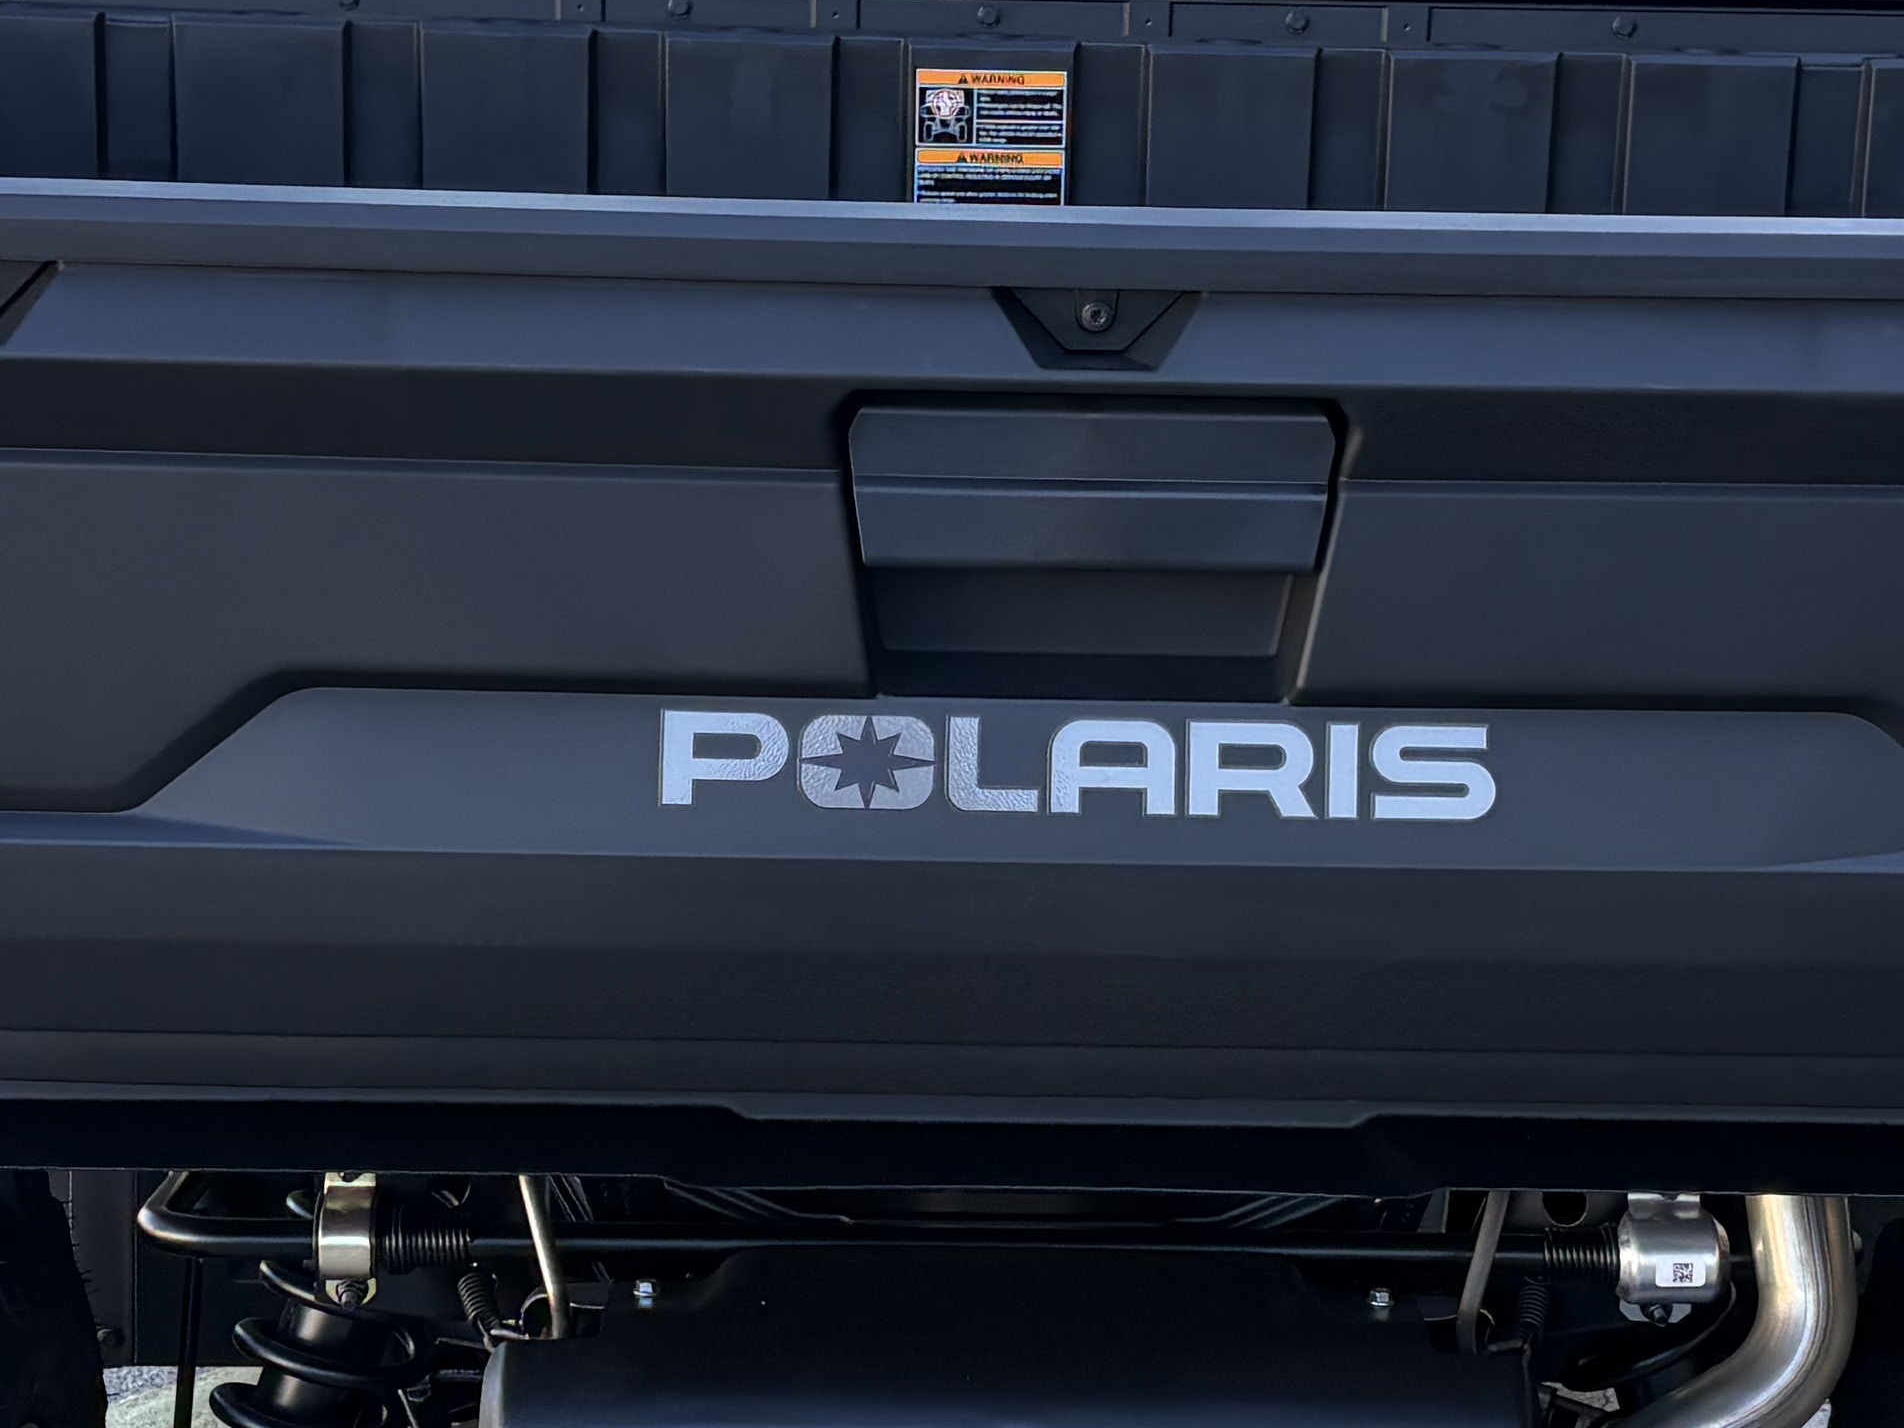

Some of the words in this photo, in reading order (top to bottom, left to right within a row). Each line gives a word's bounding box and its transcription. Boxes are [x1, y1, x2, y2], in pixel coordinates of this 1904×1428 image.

[971, 75, 1025, 86] WARNING
[969, 153, 1024, 164] WARNING
[660, 709, 1497, 822] POLARIS
